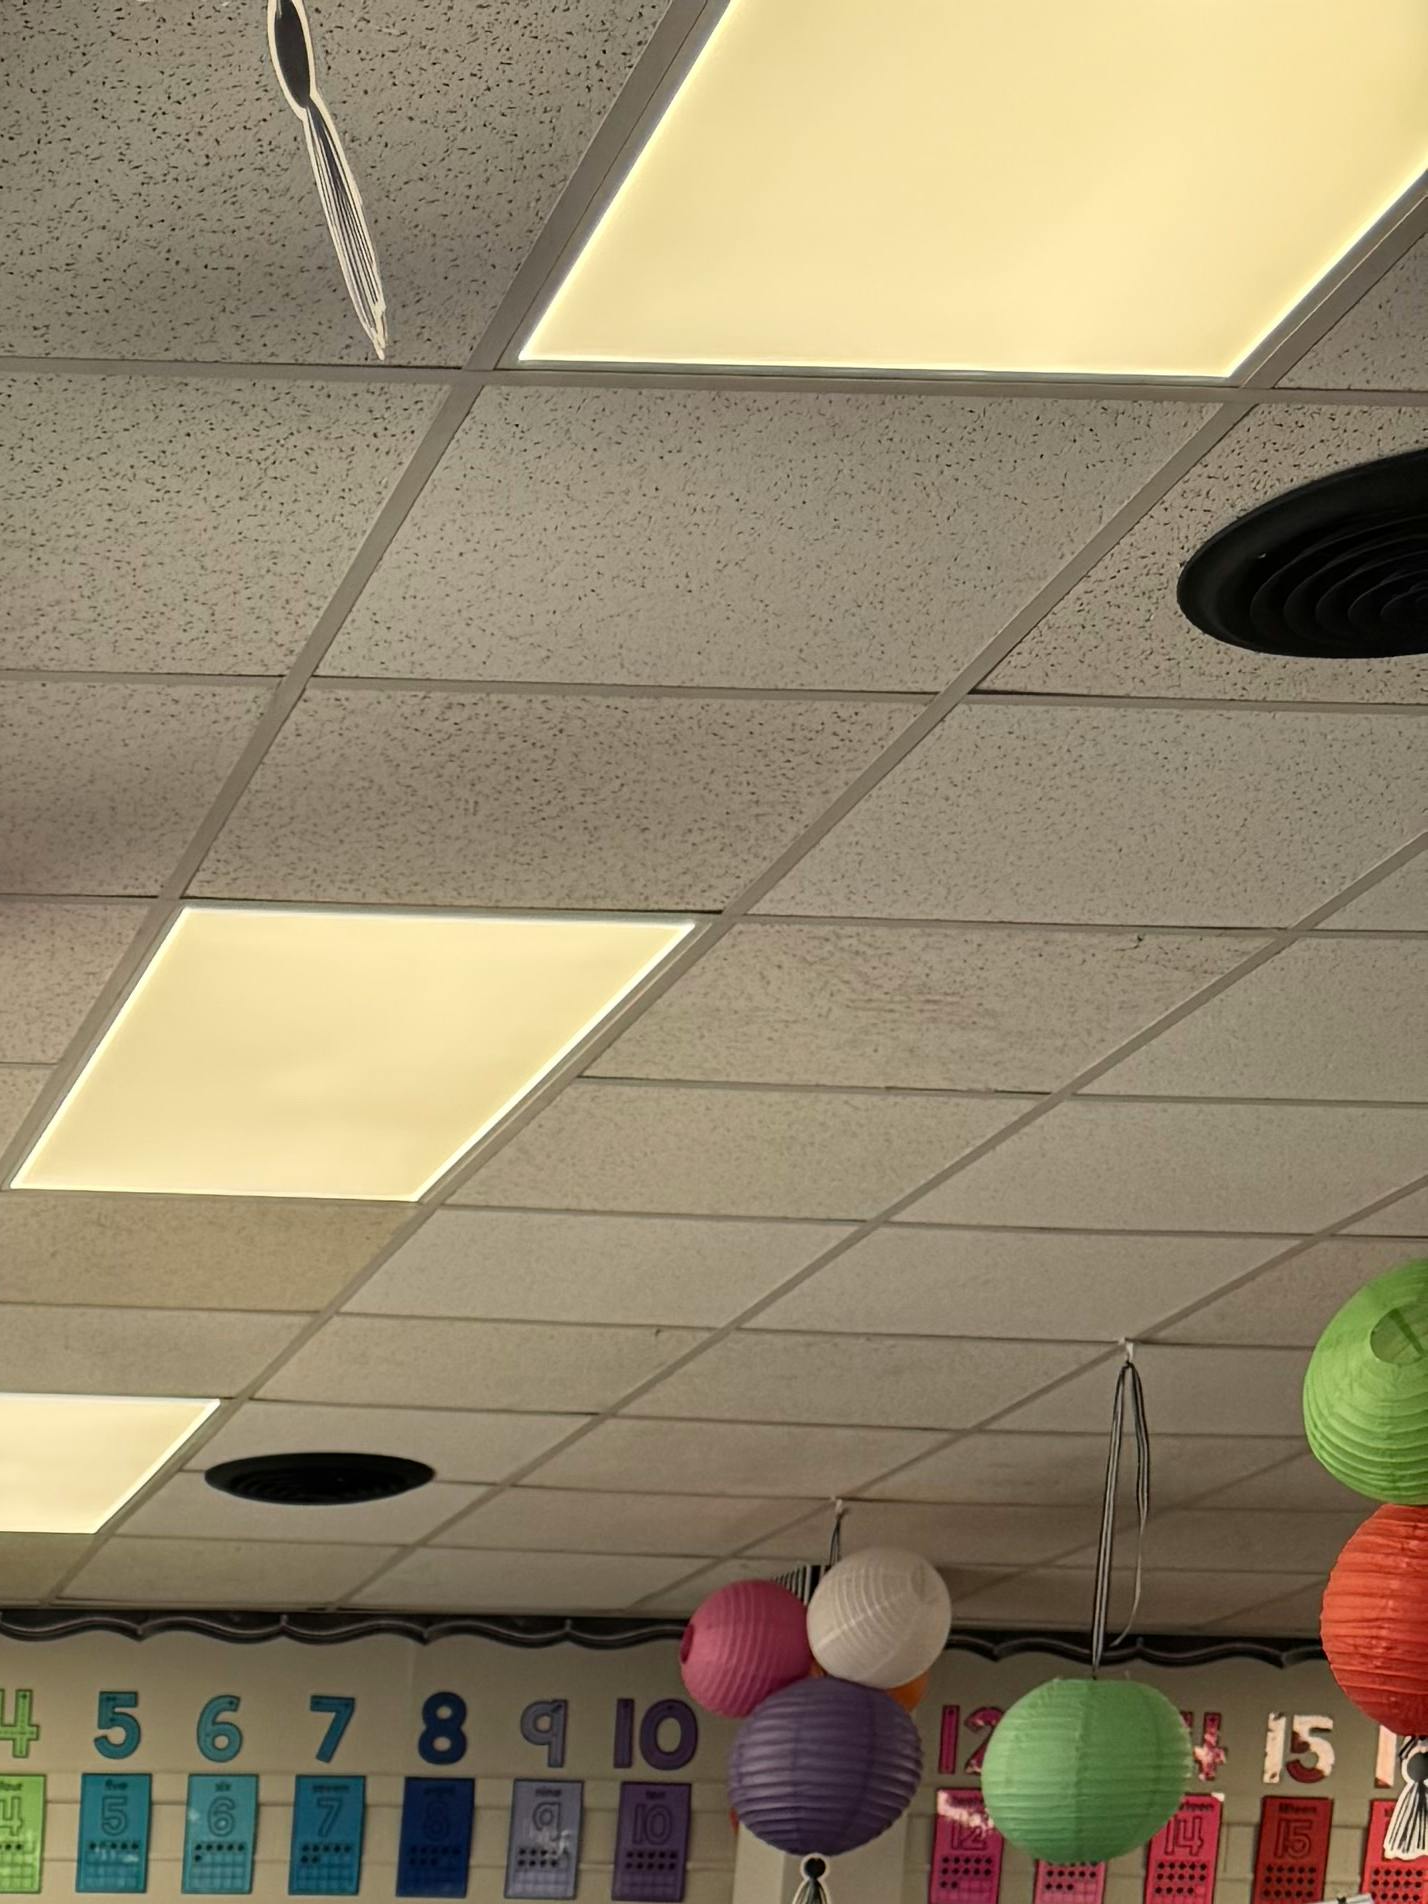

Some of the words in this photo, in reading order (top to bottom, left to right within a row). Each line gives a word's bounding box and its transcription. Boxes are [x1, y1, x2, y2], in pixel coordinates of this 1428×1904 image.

[93, 1690, 142, 1760] 5
[196, 1694, 243, 1763] 6
[310, 1695, 355, 1763] 7
[417, 1691, 467, 1765] 8
[520, 1699, 568, 1768] 9
[614, 1698, 698, 1770] 10
[1262, 1712, 1335, 1784] 15
[101, 1796, 128, 1836] 5
[208, 1797, 236, 1837] 6
[318, 1797, 342, 1838] 7
[532, 1802, 563, 1841] 9
[631, 1803, 672, 1845] 10
[1166, 1816, 1203, 1856] 14
[1274, 1819, 1314, 1859] 15
